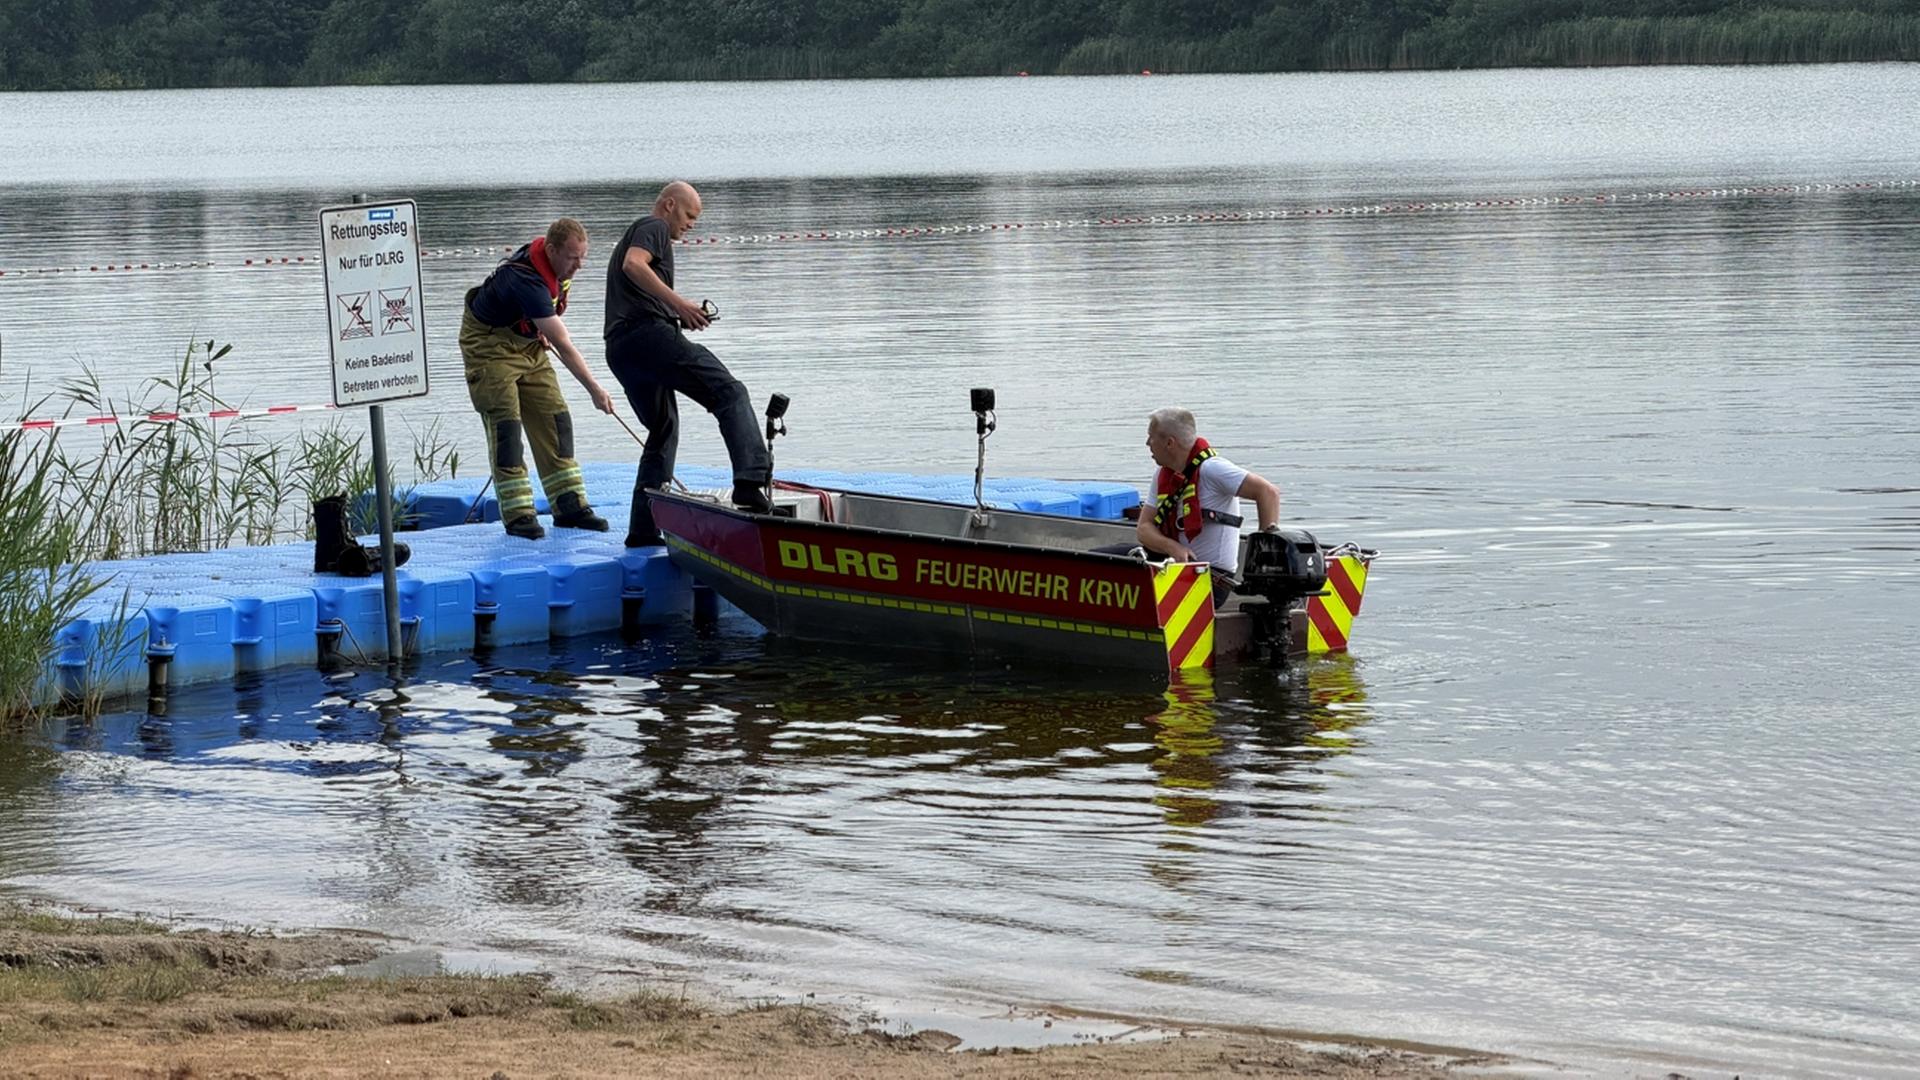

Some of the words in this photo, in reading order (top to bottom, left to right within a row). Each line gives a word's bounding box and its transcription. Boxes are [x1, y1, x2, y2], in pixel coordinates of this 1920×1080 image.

[330, 220, 408, 240] Rettungssteg
[339, 256, 357, 270] Nur
[359, 254, 374, 268] für
[375, 250, 405, 266] DLRG
[345, 357, 370, 370] Keine
[371, 350, 414, 367] Badeinsel
[343, 379, 380, 393] Betreten
[381, 374, 419, 388] verboten
[1306, 556, 1314, 566] 6
[778, 540, 898, 581] DLRG
[915, 559, 1069, 601] FEUERWEHR
[1078, 578, 1140, 610] KRW
